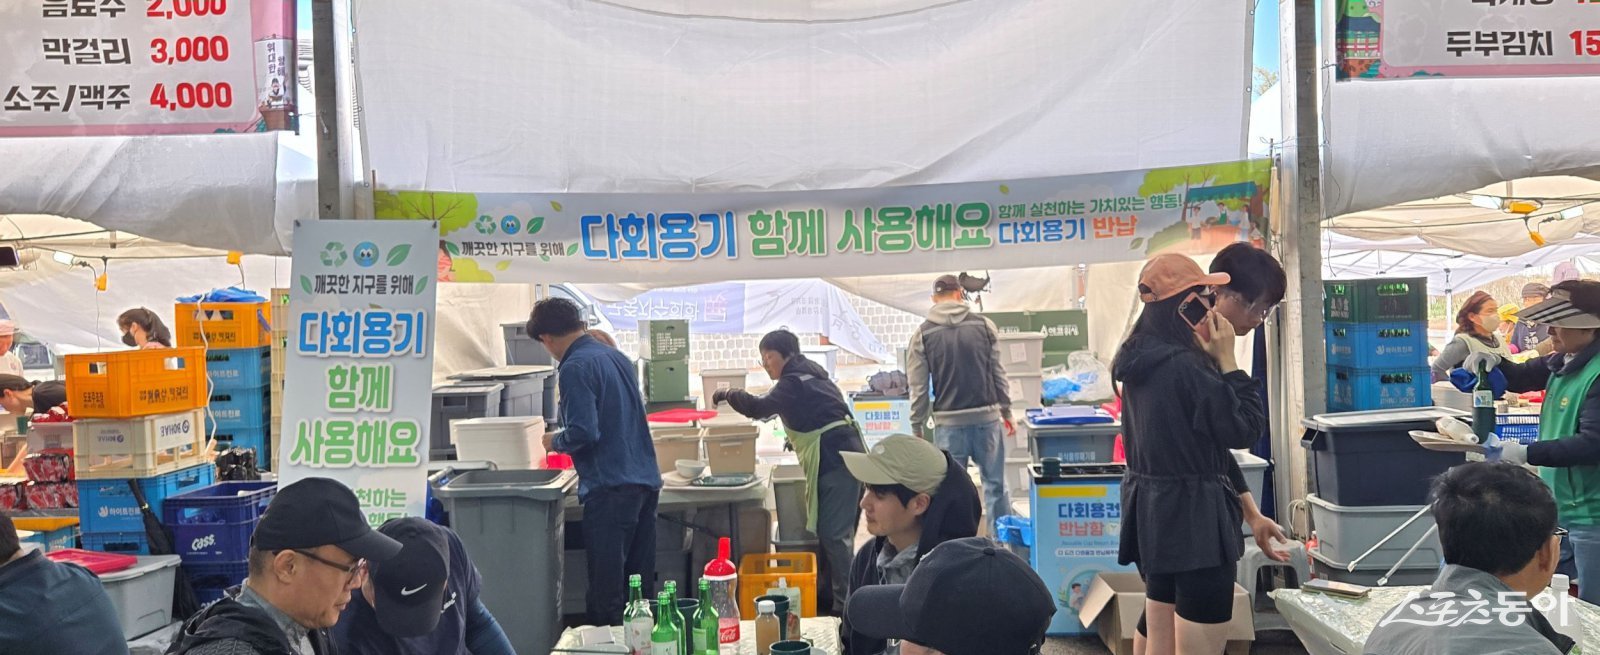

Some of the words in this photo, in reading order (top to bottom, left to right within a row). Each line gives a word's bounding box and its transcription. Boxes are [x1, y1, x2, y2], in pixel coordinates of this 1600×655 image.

[146, 0, 227, 20] 2,000
[42, 38, 131, 65] 막걸리
[150, 35, 229, 65] 3,000
[1447, 30, 1553, 57] 두부김치
[4, 84, 130, 112] 소주/맥주
[150, 82, 232, 111] 4,000
[998, 204, 1026, 219] 함께
[1030, 201, 1085, 217] 실천하는
[1090, 197, 1145, 214] 가치있는
[1150, 193, 1182, 210] 행동!
[580, 210, 737, 261] 다회용기
[747, 208, 827, 258] 함께
[835, 202, 994, 254] 사용해요
[999, 218, 1086, 244] 다회용기
[1093, 215, 1138, 239] 반납
[462, 241, 498, 256] 깨끗한
[501, 241, 537, 256] 지구를
[540, 242, 565, 256] 위해
[314, 274, 350, 295] 깨끗한
[352, 274, 387, 295] 지구를
[390, 274, 414, 295] 위해
[297, 309, 426, 356] 다회용기
[326, 363, 393, 411] 함께
[160, 420, 182, 437] BOHAE
[289, 419, 420, 466] 사용해요
[355, 487, 407, 508] 천하는
[1059, 521, 1104, 537] 반납함
